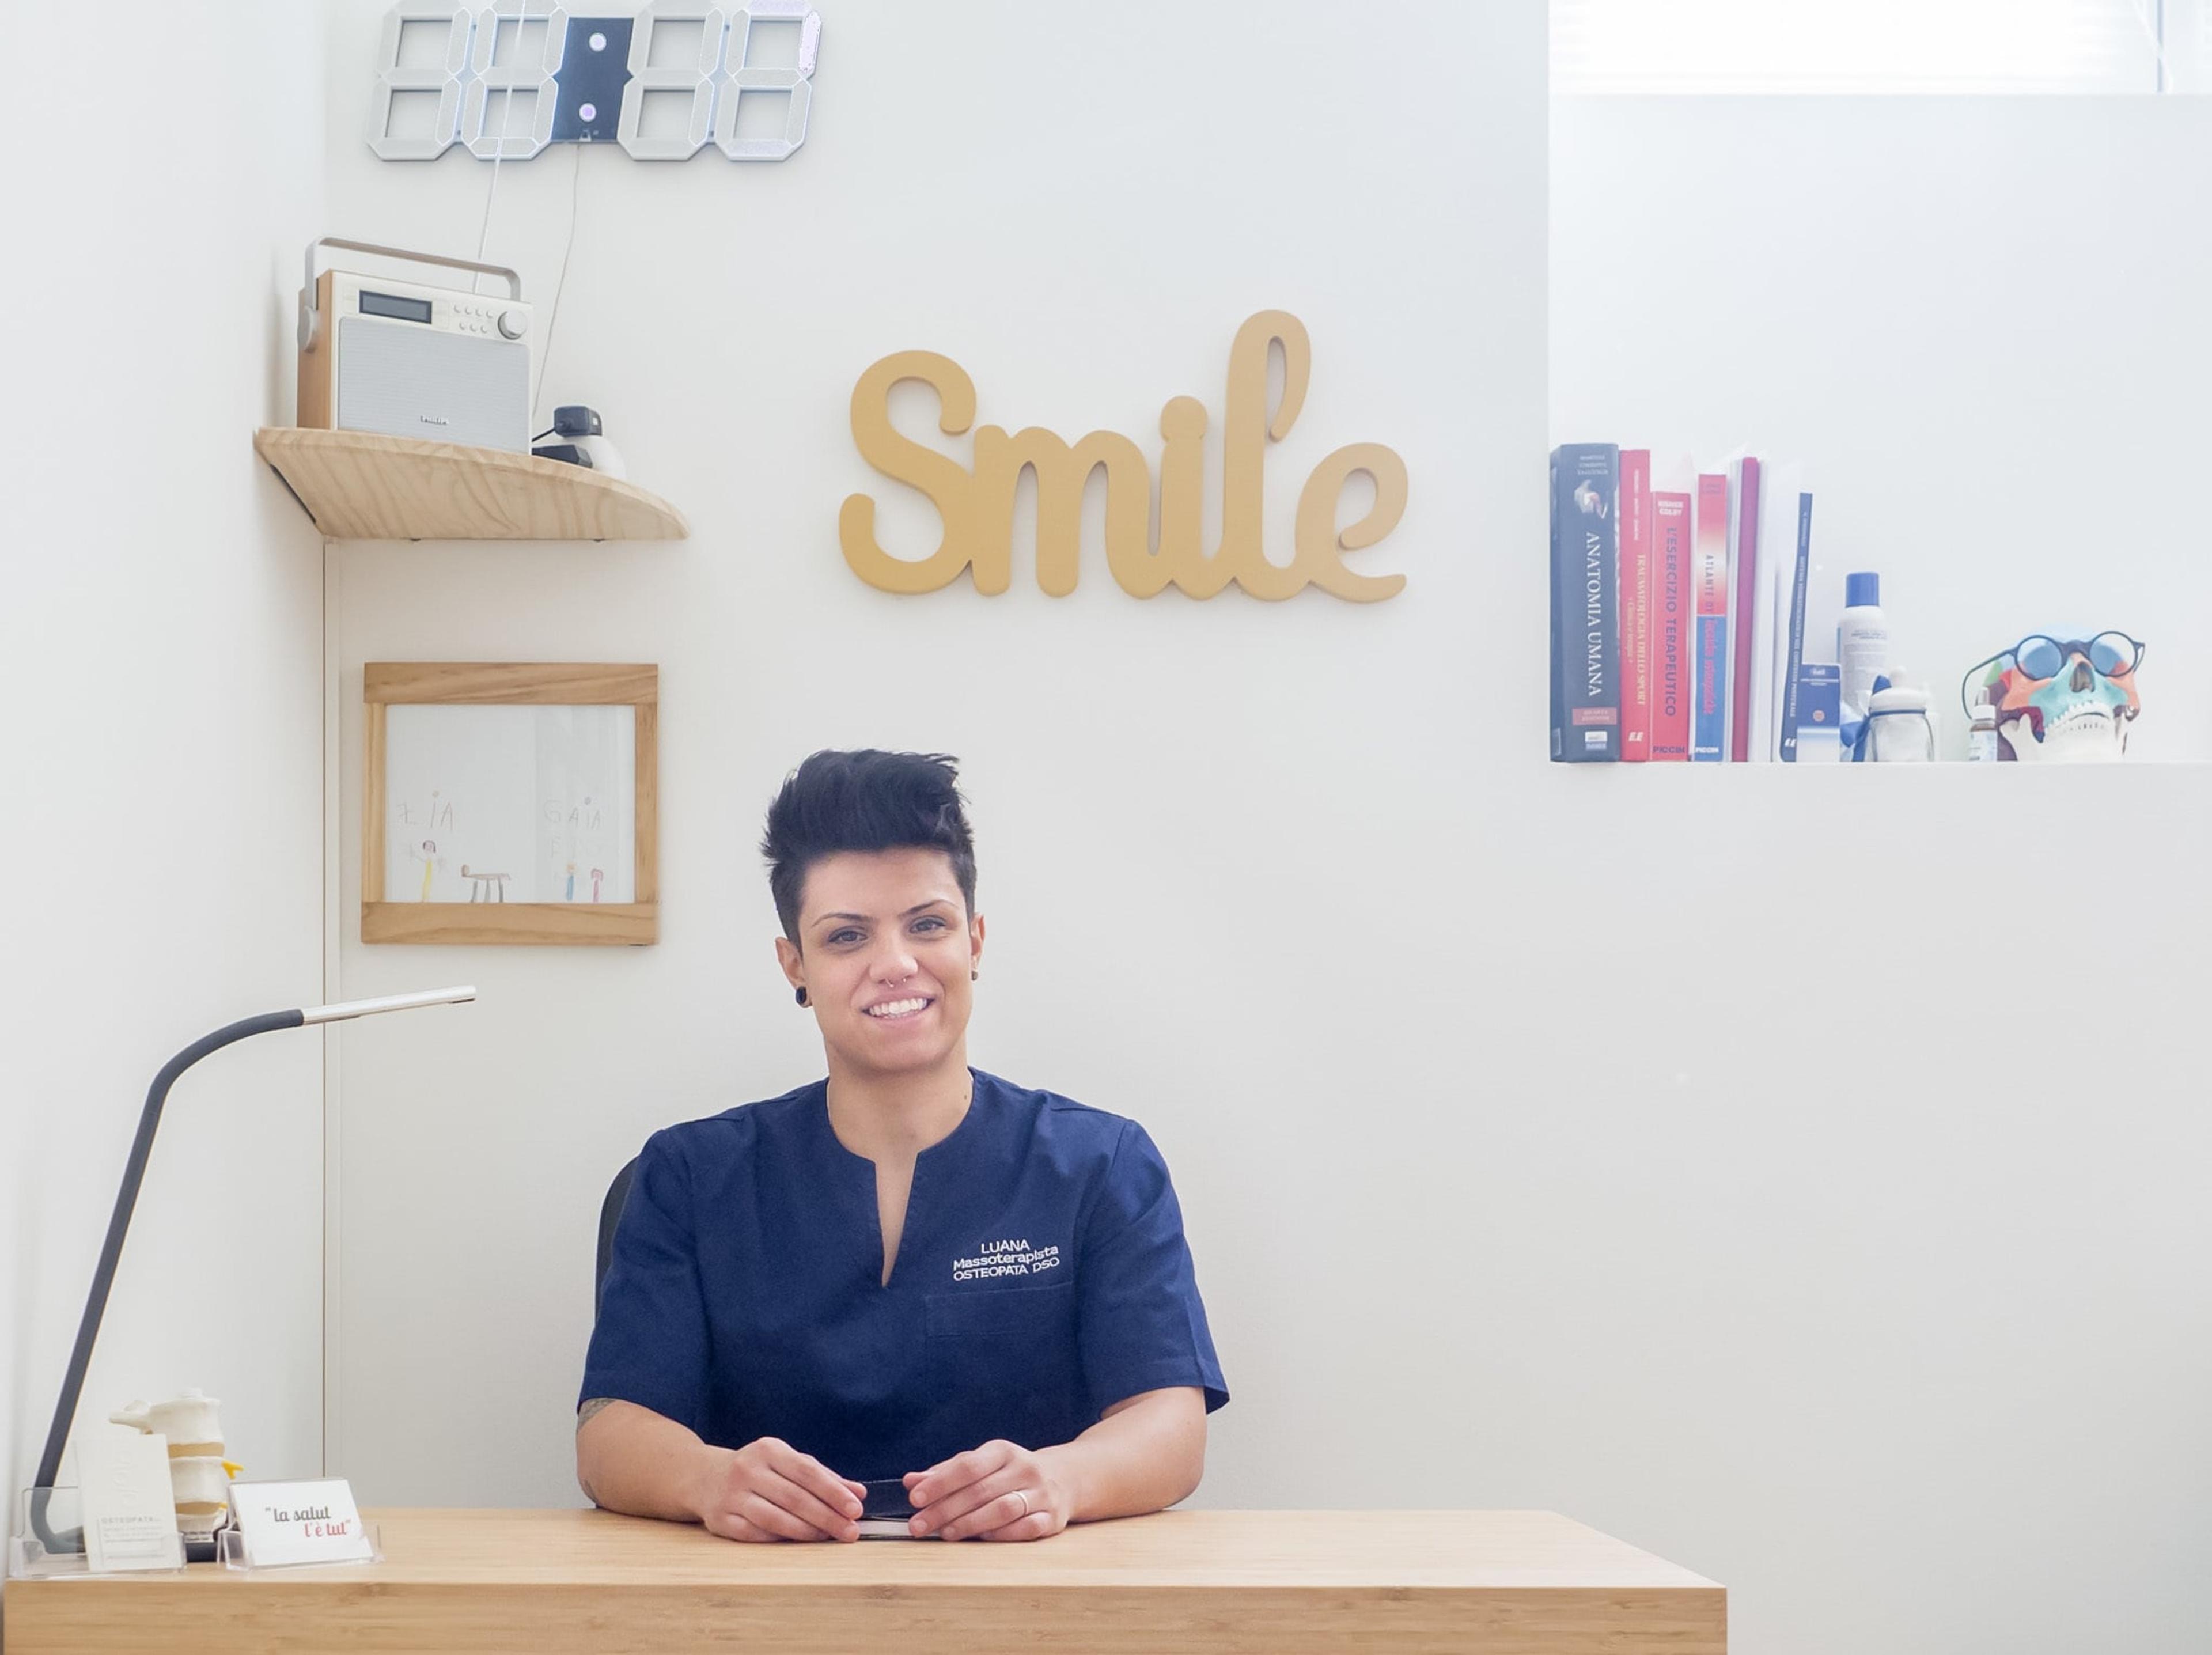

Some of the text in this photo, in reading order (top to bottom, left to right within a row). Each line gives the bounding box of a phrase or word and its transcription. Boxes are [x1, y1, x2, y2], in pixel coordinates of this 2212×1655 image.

[839, 309, 1408, 603] Smile
[1586, 532, 1601, 626] ANATOMIA
[1705, 554, 1714, 597] ATLANTE
[1665, 527, 1677, 716] L'ESERCIZIO TERAPEUTICO
[1587, 631, 1602, 696] UMANA
[953, 1245, 1059, 1271] Massoterapista
[953, 1256, 1060, 1281] OSTEOPATA DSO
[981, 1239, 1030, 1253] LUANA
